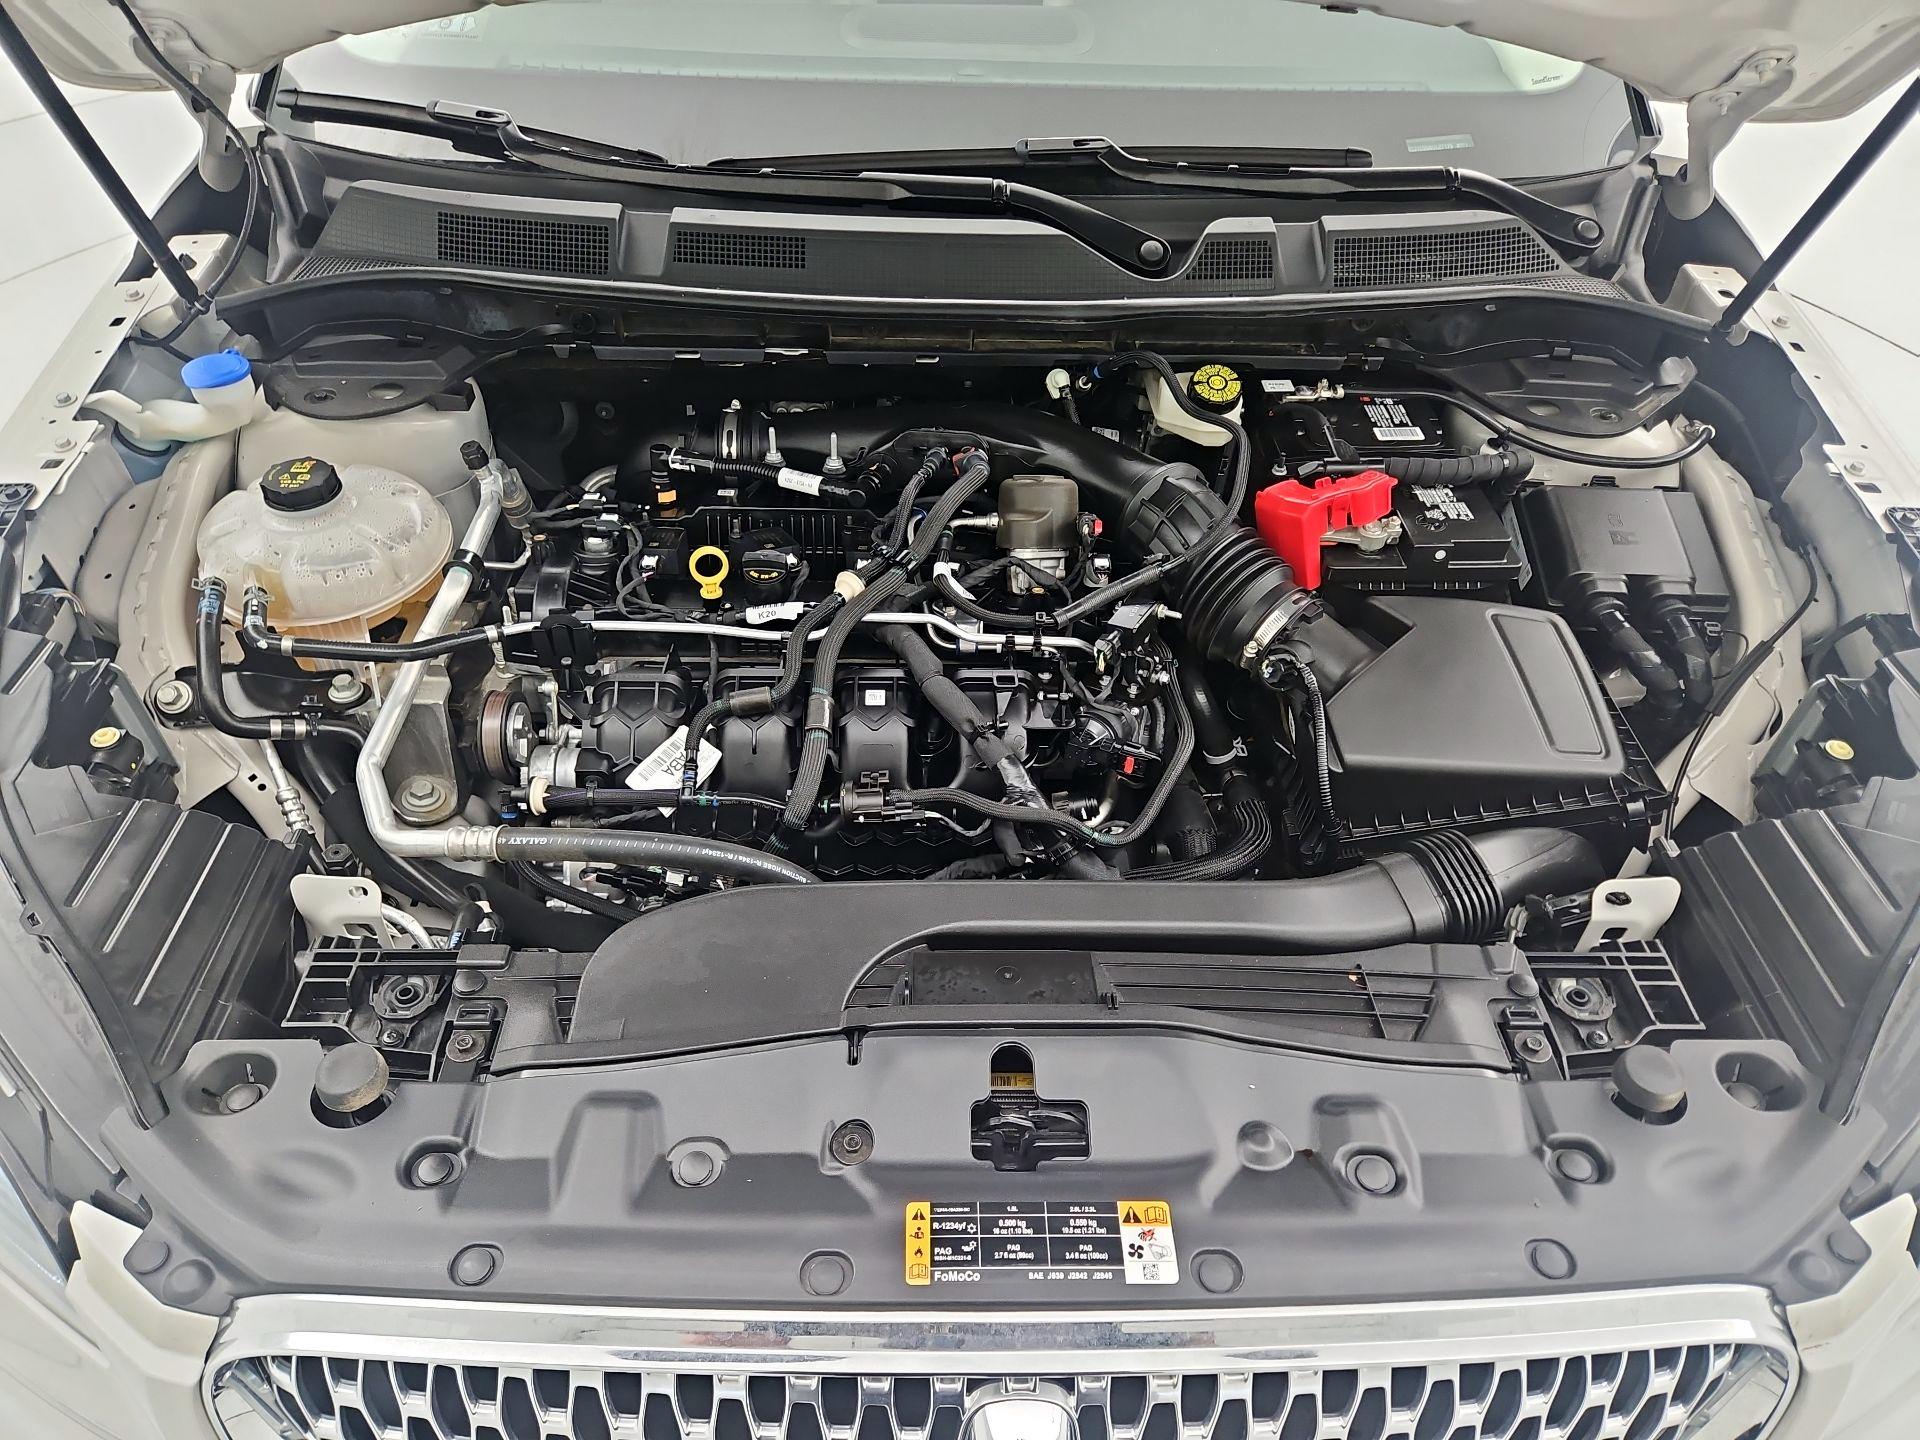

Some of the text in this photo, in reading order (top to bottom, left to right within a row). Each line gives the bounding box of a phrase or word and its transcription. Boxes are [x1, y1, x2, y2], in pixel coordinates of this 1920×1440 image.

[758, 610, 777, 620] K20
[507, 837, 548, 845] GALAXY
[761, 860, 782, 873] HOSE
[933, 1222, 966, 1231] R-1234yf
[998, 1219, 1026, 1229] 0.500 kg
[1088, 1218, 1097, 1228] kg
[1095, 1227, 1107, 1235] lbs)
[934, 1247, 952, 1255] PAG
[1087, 1252, 1108, 1261] (100cc)
[934, 1270, 981, 1282] FoMoCo
[1028, 1272, 1045, 1280] SAE
